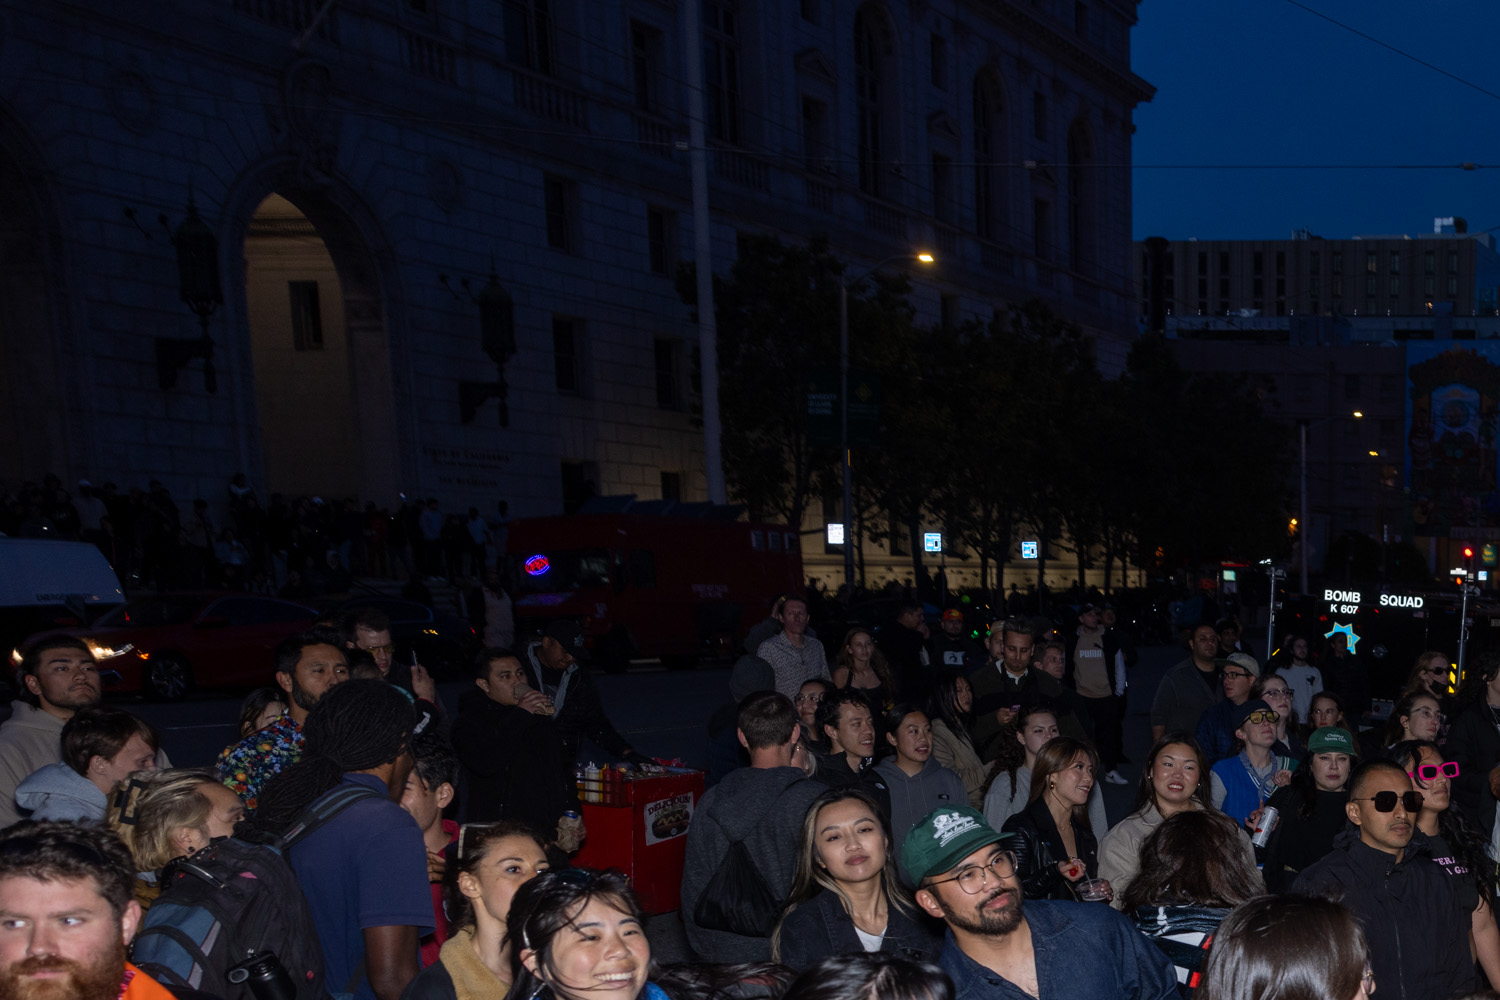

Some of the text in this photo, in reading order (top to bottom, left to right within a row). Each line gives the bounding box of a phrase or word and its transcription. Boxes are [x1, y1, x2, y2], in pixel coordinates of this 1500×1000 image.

[1324, 589, 1424, 608] BOMB SQUAD
[1330, 604, 1359, 614] K 607
[1079, 649, 1102, 658] PUMA
